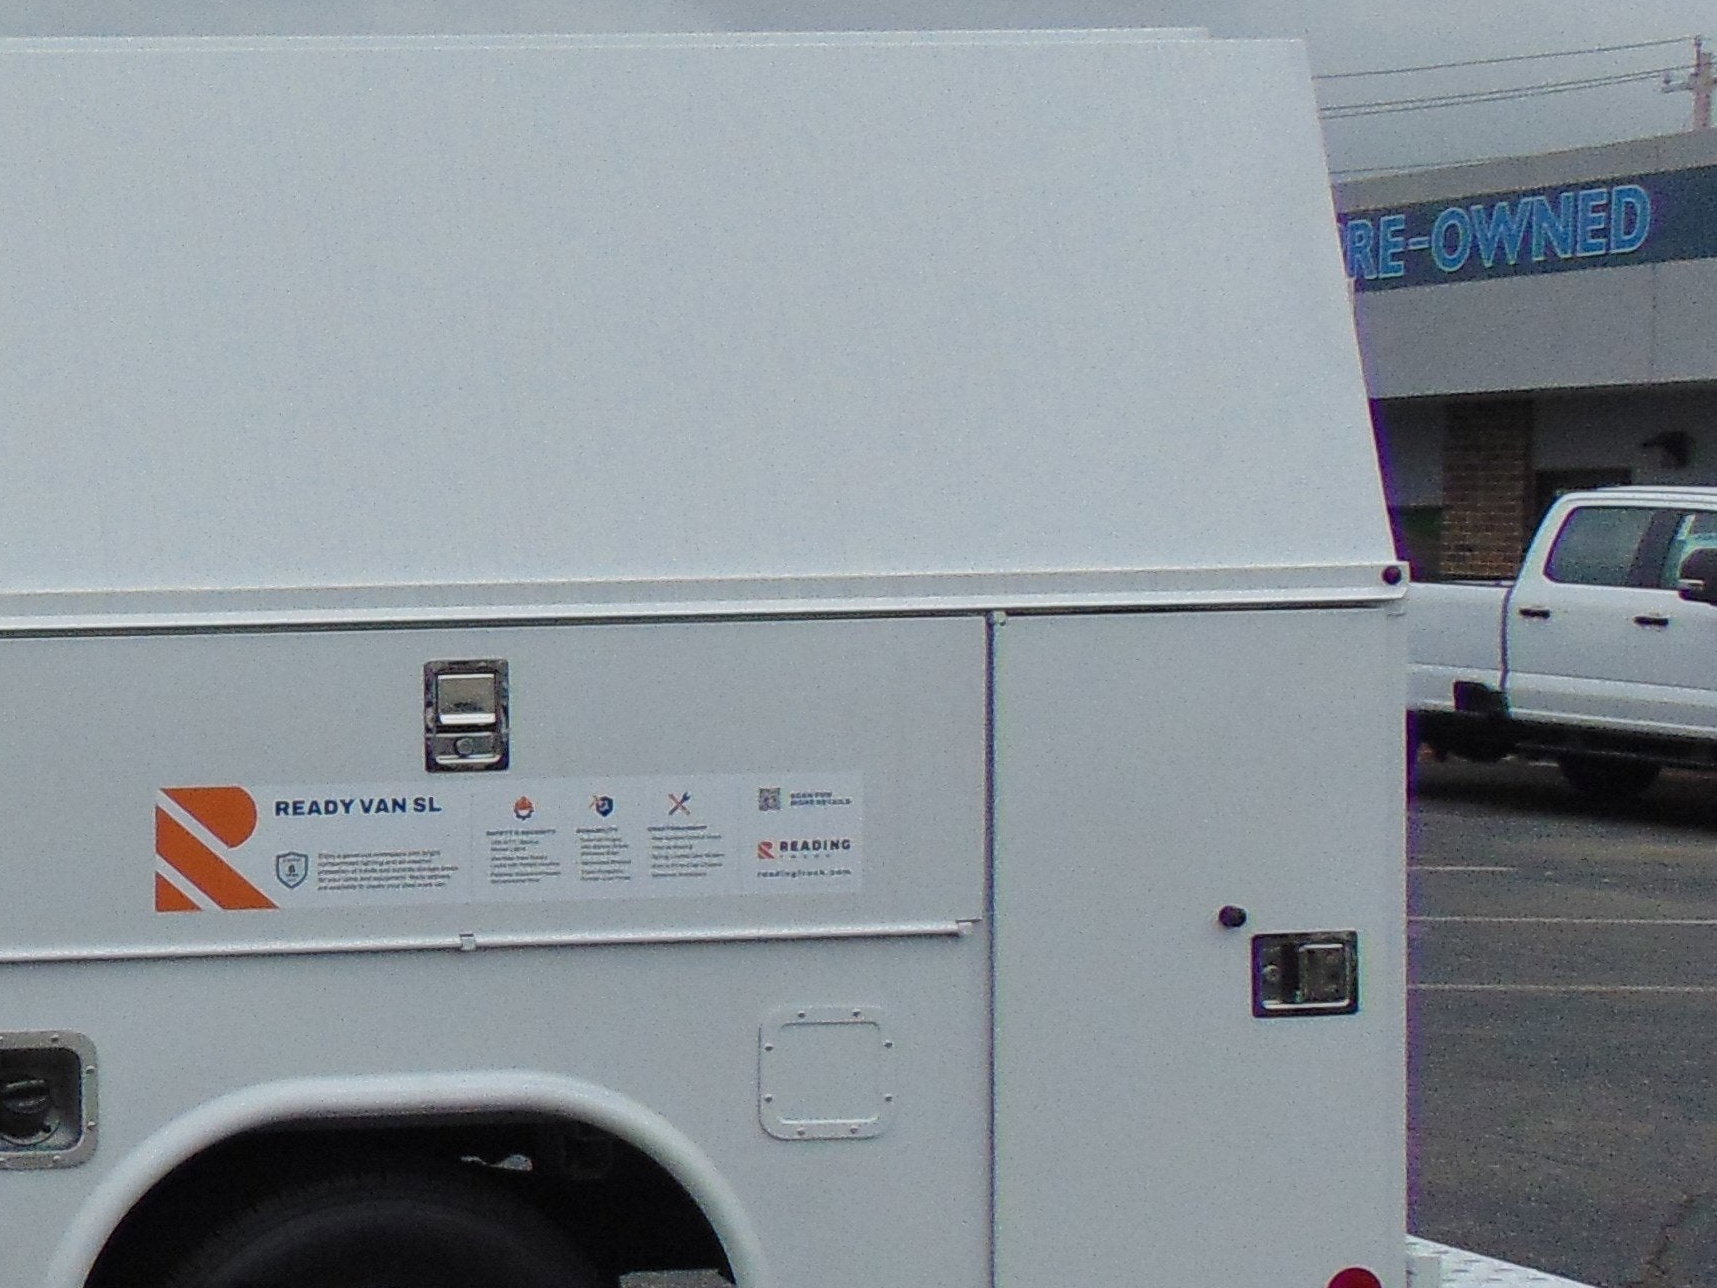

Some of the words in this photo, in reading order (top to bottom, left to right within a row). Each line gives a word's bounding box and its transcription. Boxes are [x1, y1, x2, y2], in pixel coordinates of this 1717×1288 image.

[1338, 184, 1652, 280] RE-OWNED
[274, 799, 355, 817] READY
[359, 797, 407, 815] VAN
[412, 796, 443, 814] SL
[779, 839, 852, 852] READING
